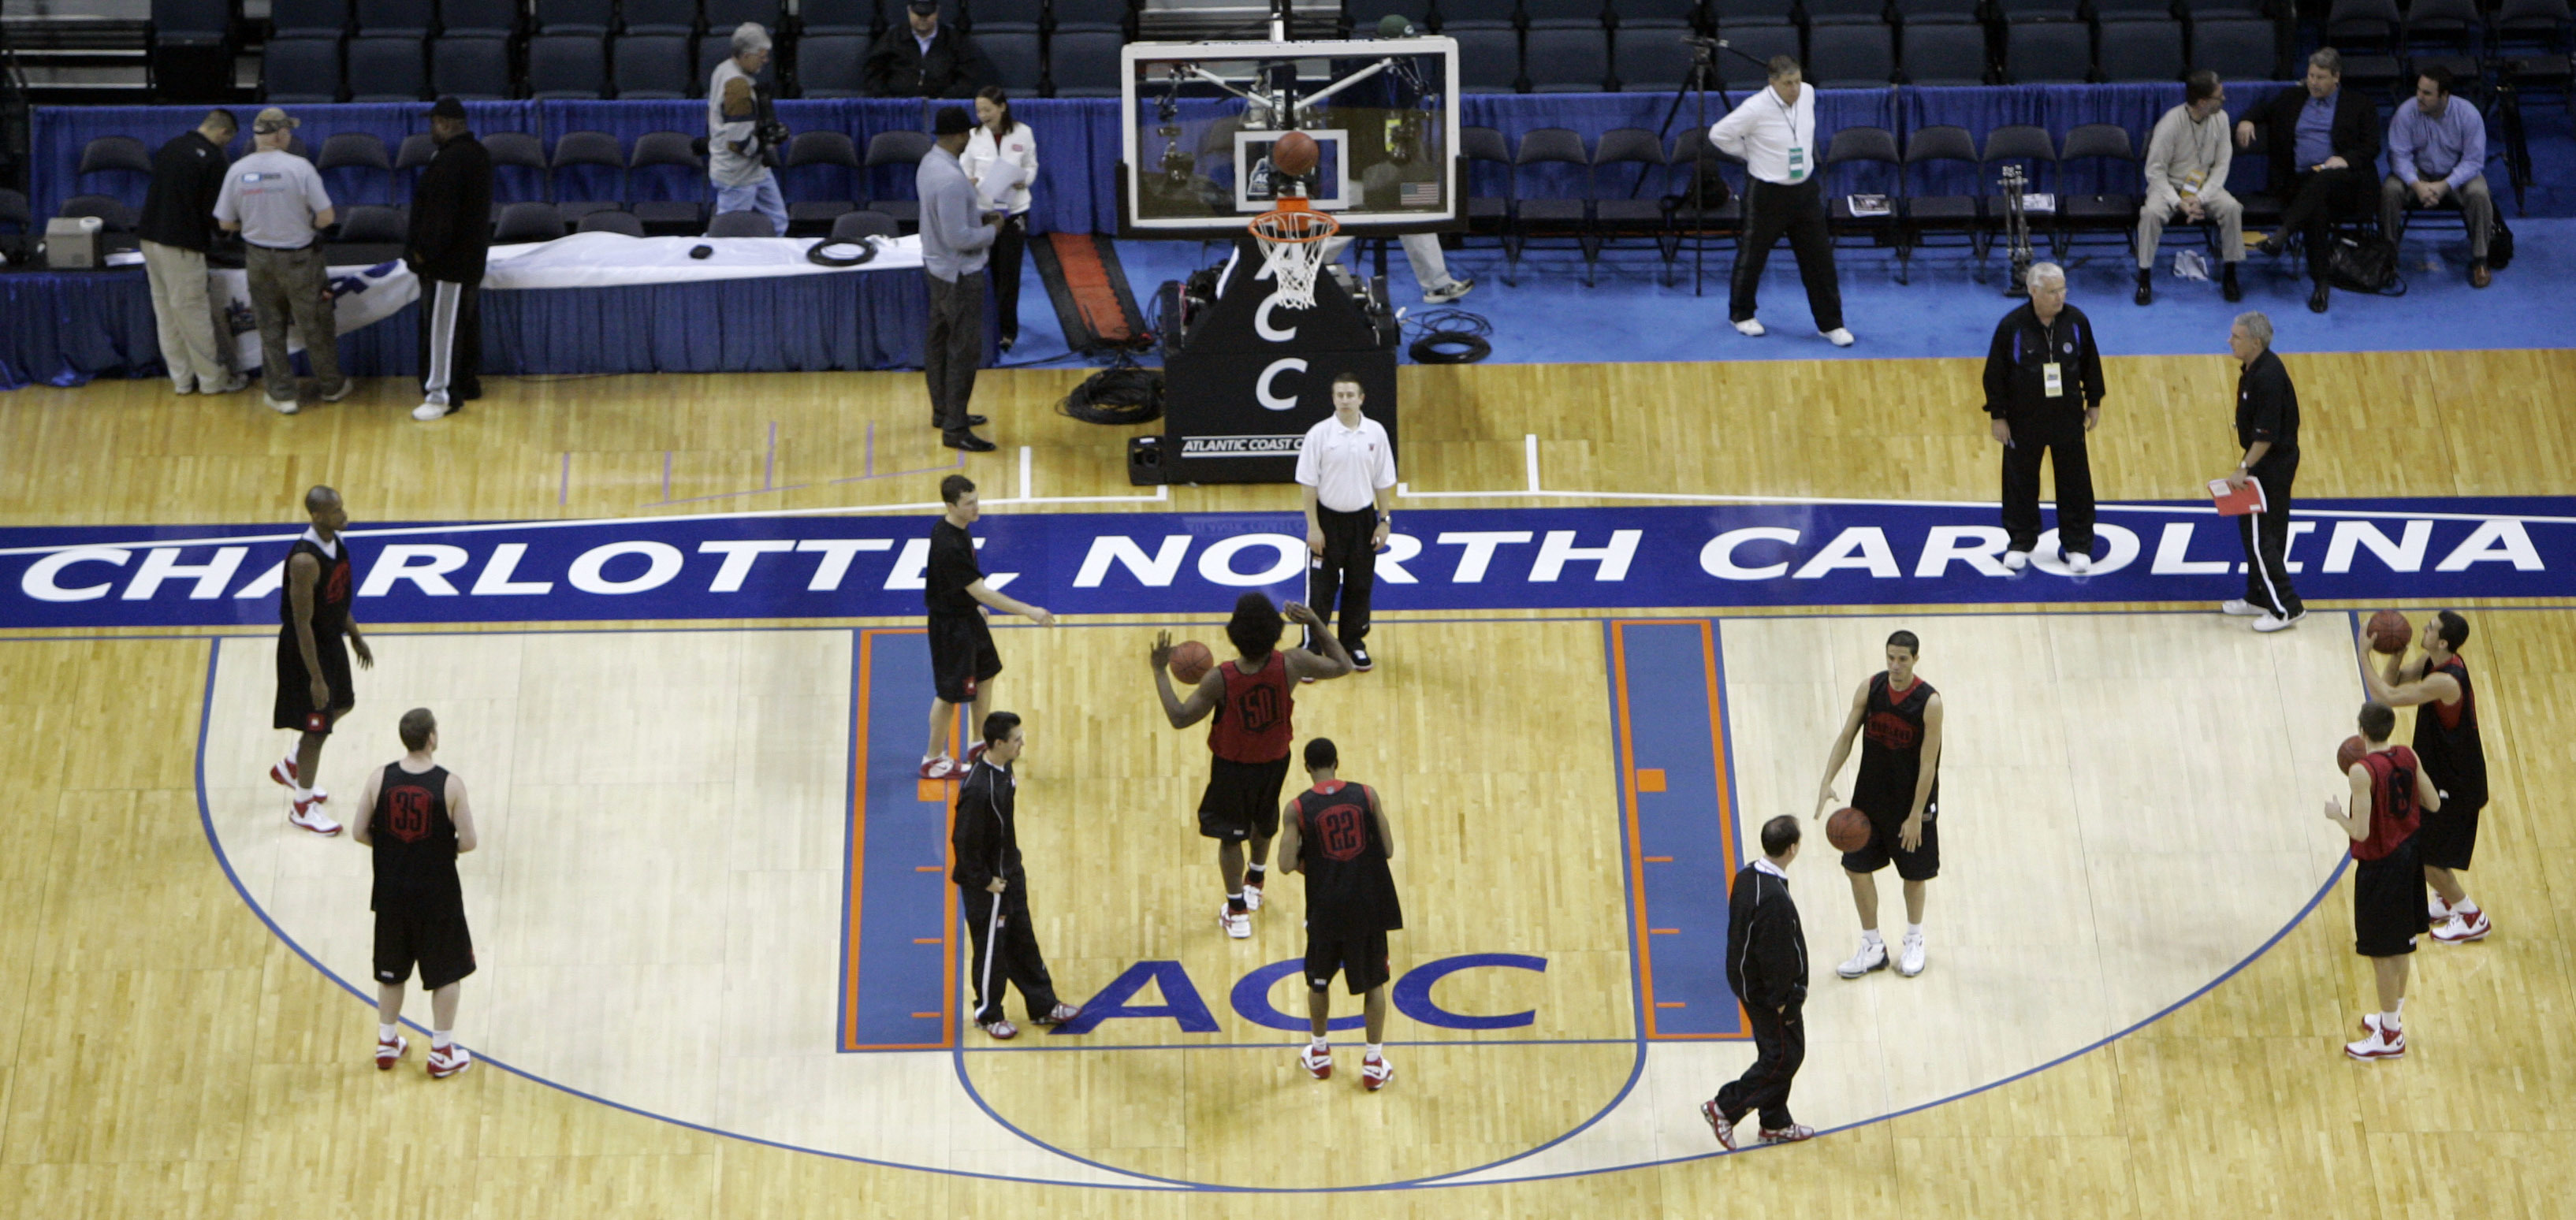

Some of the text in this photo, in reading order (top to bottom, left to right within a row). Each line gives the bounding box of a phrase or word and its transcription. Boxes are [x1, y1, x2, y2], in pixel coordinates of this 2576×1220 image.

[1183, 439, 1246, 452] ATLANTIC
[1248, 438, 1292, 451] COAST
[1245, 689, 1273, 728] 50
[396, 792, 422, 831] 35
[1327, 811, 1357, 851] 22
[1048, 953, 1547, 1035] ACC
